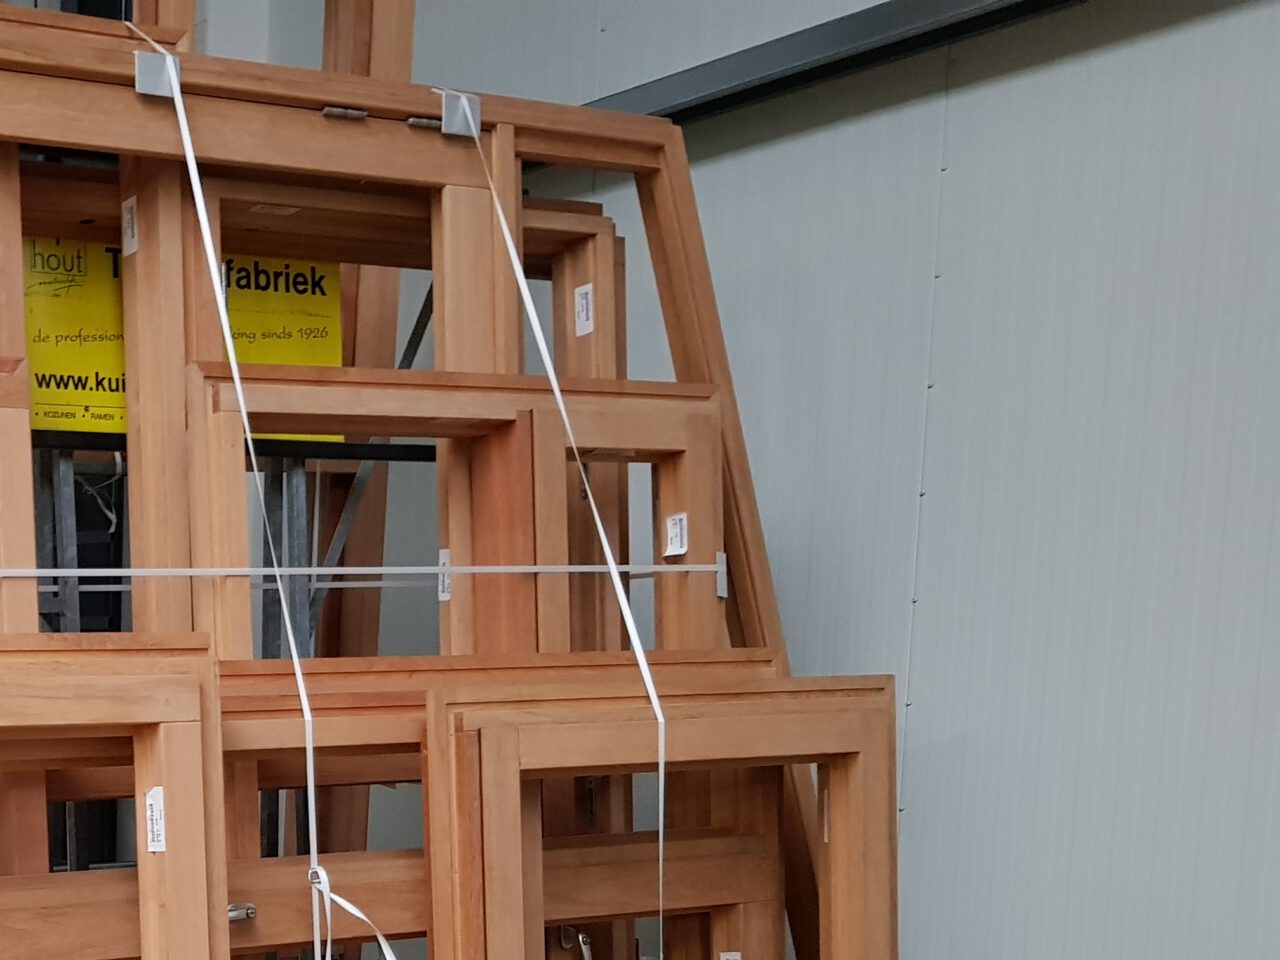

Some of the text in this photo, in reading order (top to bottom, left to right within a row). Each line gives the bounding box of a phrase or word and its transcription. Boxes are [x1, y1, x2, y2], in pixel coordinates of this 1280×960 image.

[32, 239, 83, 273] hout
[225, 258, 327, 296] fabriek
[32, 328, 50, 343] de
[261, 326, 293, 340] sinds
[297, 326, 329, 340] 1926
[34, 371, 126, 393] www.kui
